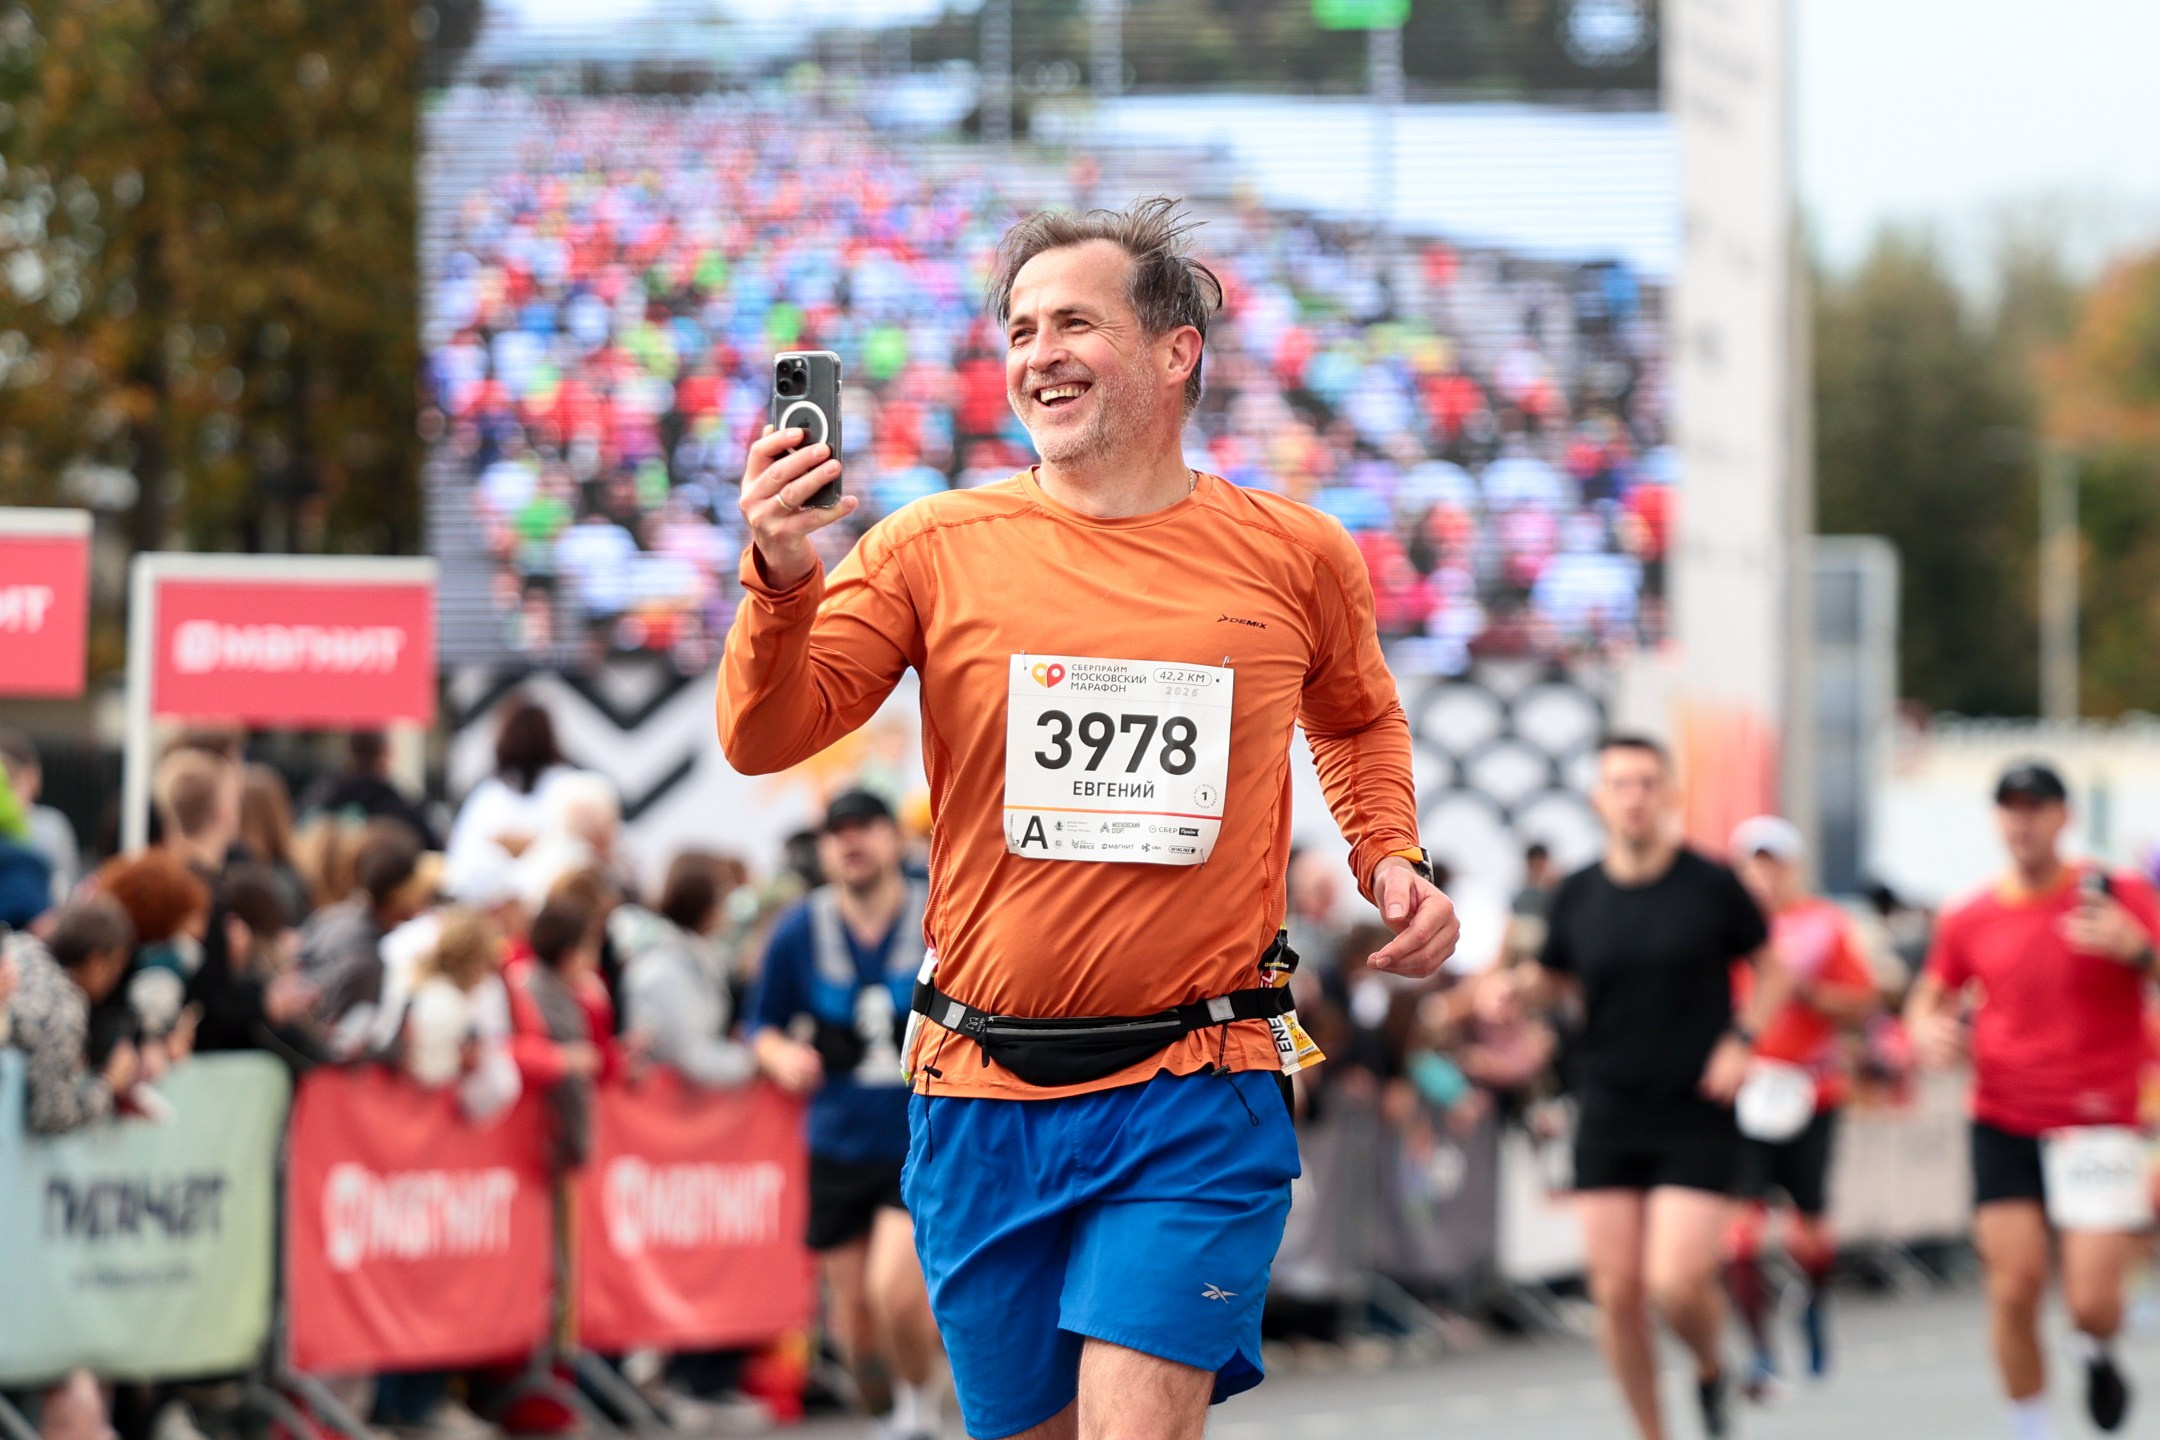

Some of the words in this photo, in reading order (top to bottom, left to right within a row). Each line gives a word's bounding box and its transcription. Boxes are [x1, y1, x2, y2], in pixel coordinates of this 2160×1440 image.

[1229, 618, 1267, 629] DEMIX
[1071, 663, 1128, 673] СБЕРПРАЙМ
[1071, 672, 1147, 684] МОСКОВСКИЙ
[1159, 671, 1184, 681] 42,2
[1187, 673, 1205, 683] КМ
[1070, 682, 1126, 693] МАРАФОН
[1034, 709, 1198, 776] 3978
[1073, 780, 1155, 799] ЕВГЕНИЙ
[1201, 791, 1208, 801] 1
